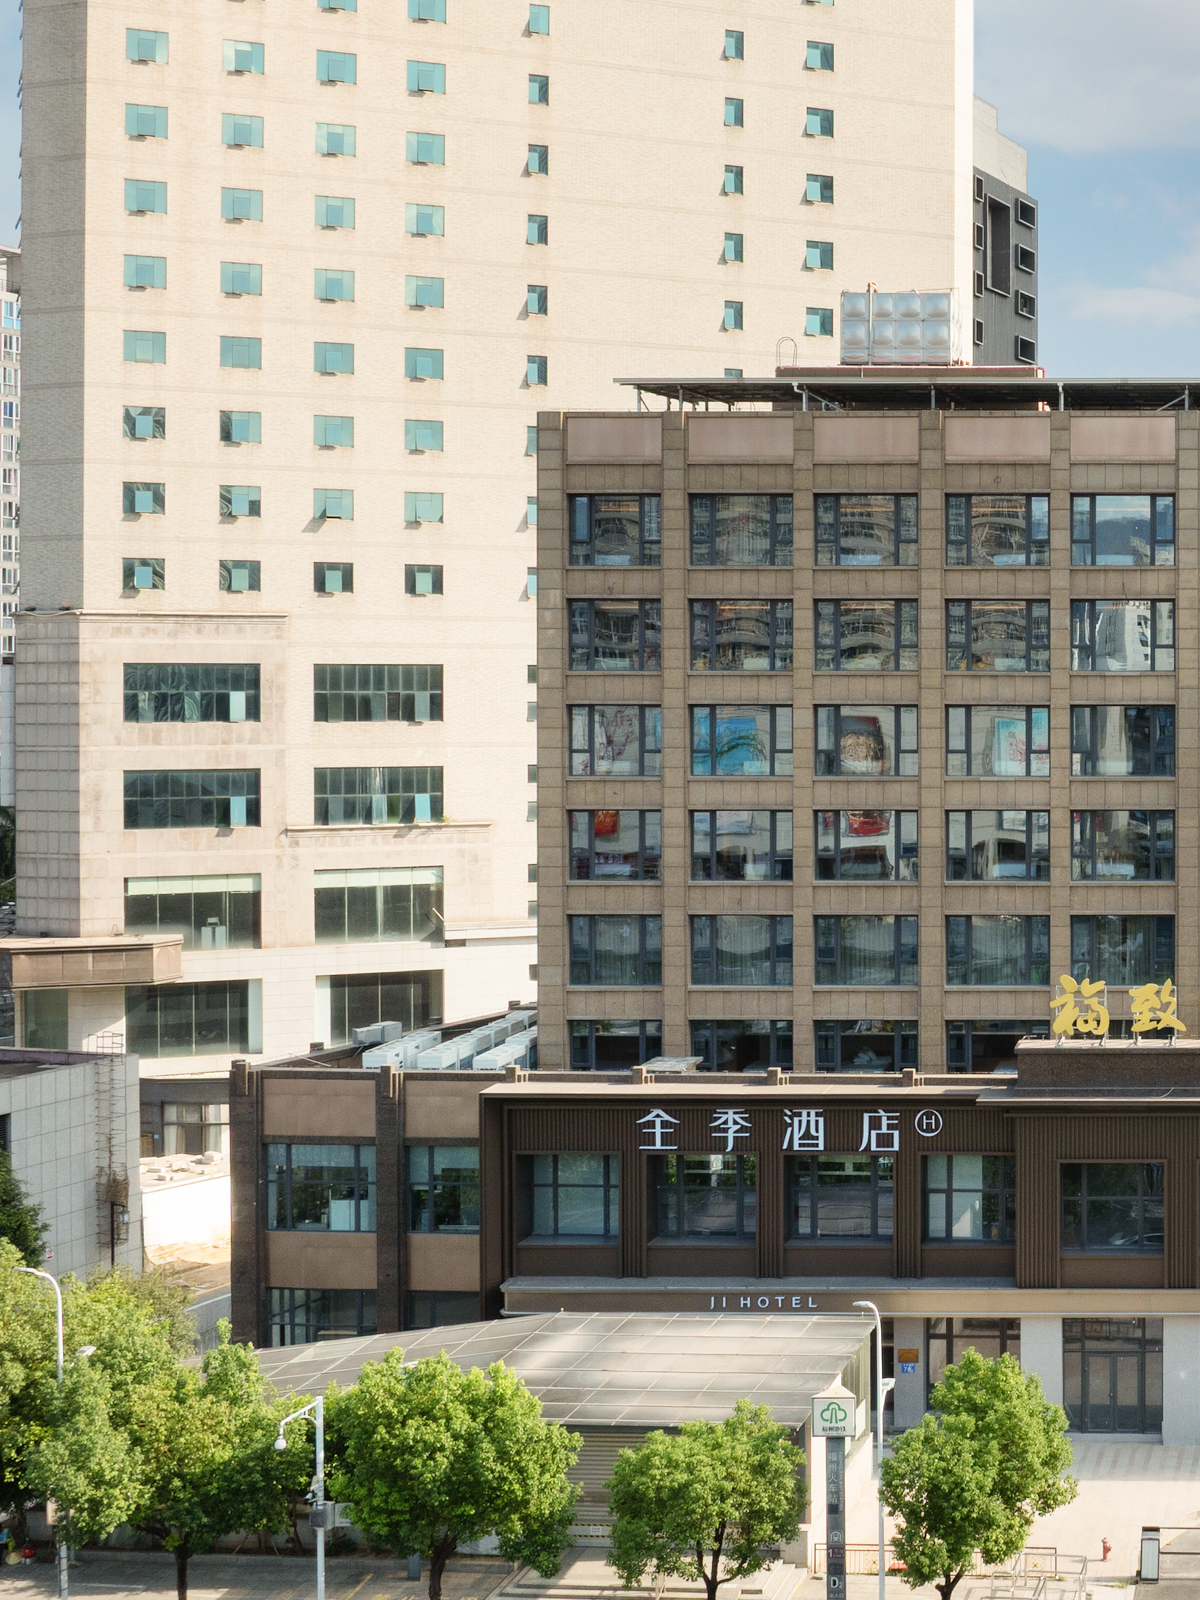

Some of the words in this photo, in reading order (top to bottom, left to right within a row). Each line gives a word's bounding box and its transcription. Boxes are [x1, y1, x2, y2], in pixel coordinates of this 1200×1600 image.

[635, 1108, 901, 1152] 全季酒店
[710, 1296, 726, 1310] JI
[740, 1296, 818, 1308] HOTEL
[828, 1451, 838, 1504] 福州火车站
